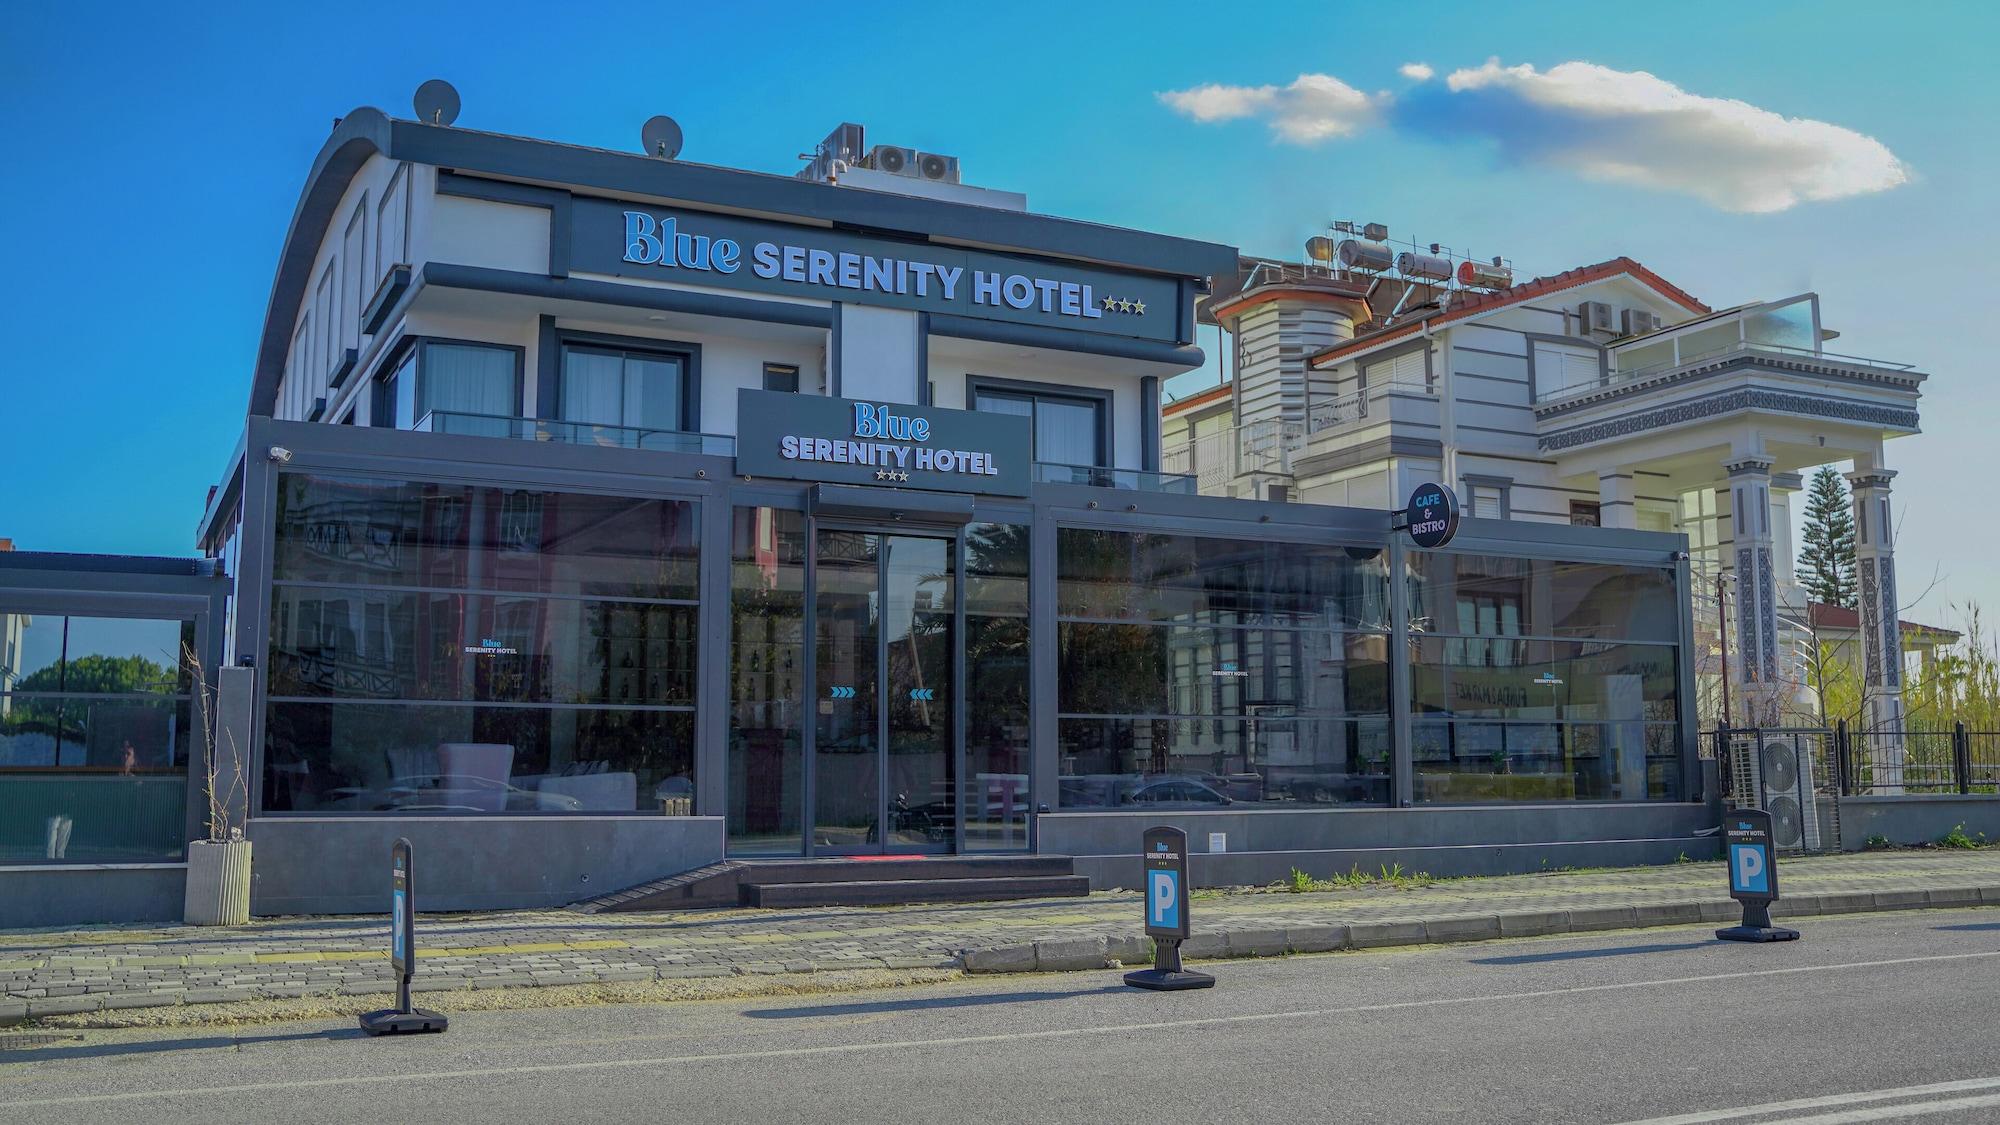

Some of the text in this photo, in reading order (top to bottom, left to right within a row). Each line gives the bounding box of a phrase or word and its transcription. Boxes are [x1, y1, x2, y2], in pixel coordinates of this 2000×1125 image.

[623, 211, 1102, 318] Blue SERENITY HOTEL
[854, 402, 930, 441] Blue
[781, 435, 998, 475] SERENITY HOTEL
[1415, 493, 1440, 508] CAFE
[1424, 508, 1432, 519] &
[1412, 519, 1446, 535] BISTRO
[482, 638, 502, 647] Blue
[1738, 847, 1763, 888] P
[1154, 873, 1175, 922] P
[395, 895, 403, 952] P
